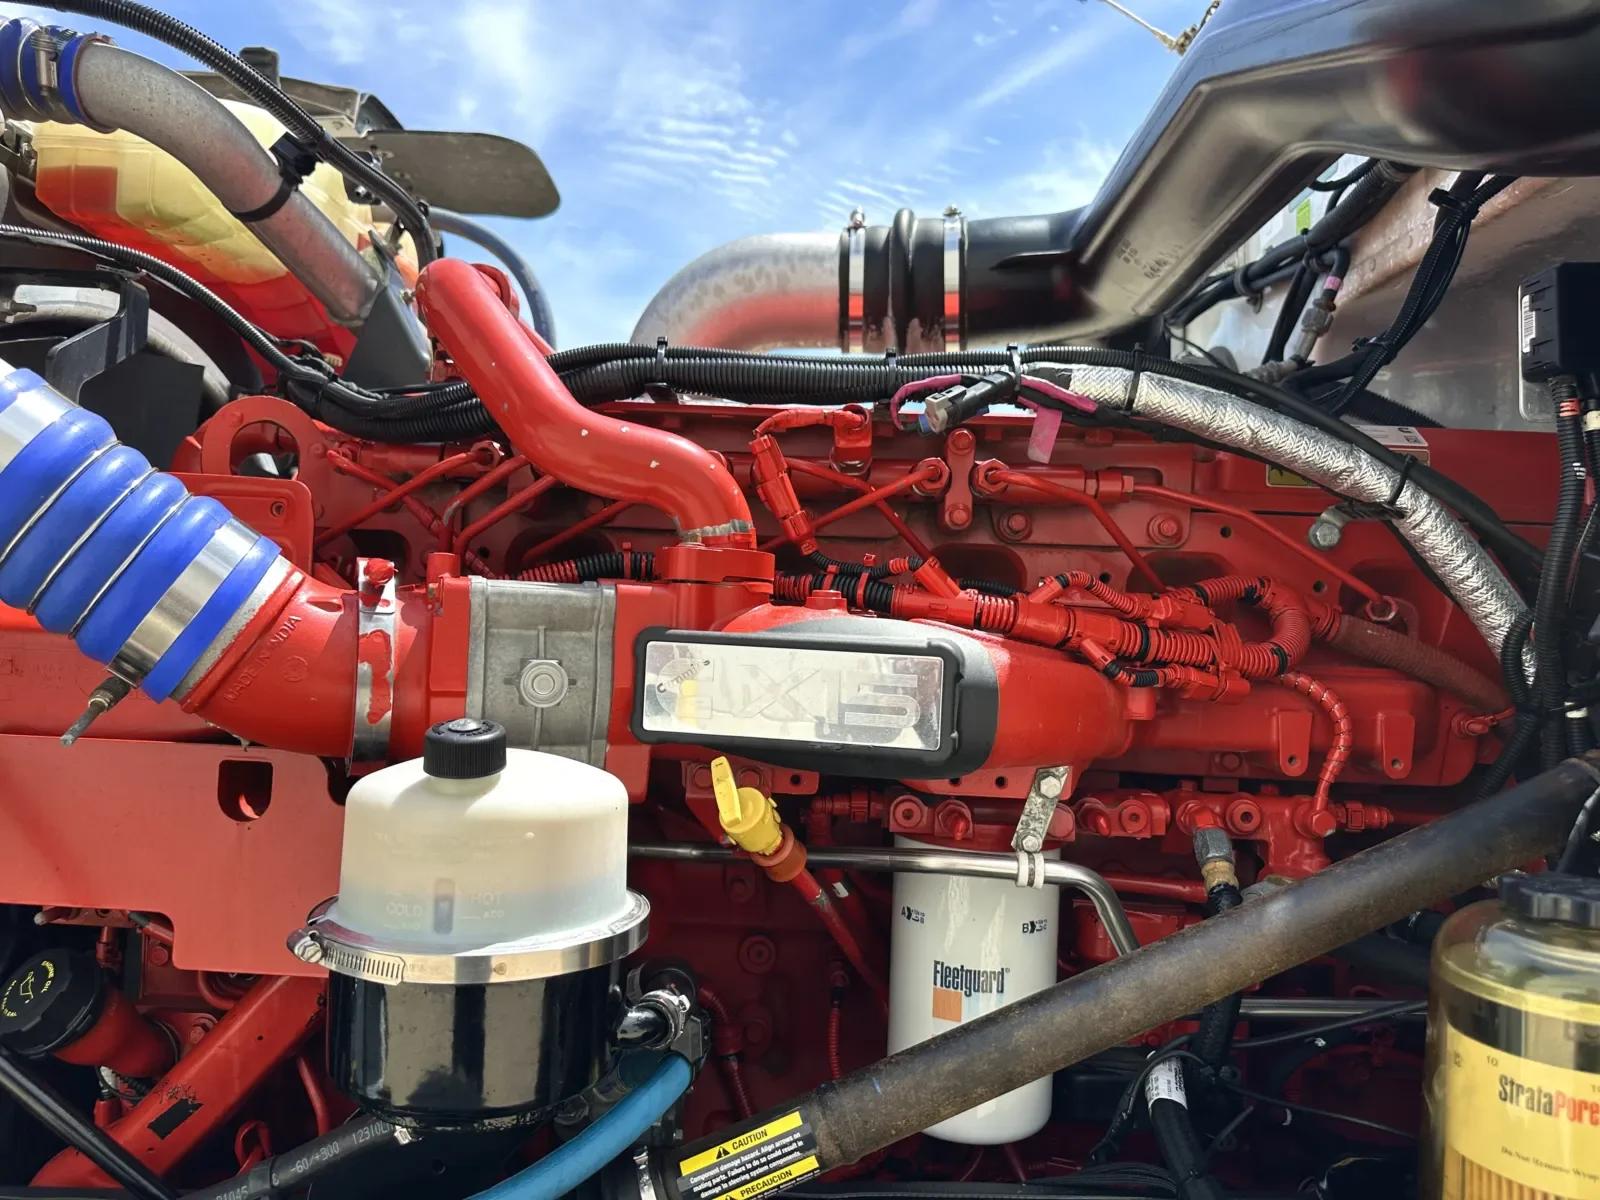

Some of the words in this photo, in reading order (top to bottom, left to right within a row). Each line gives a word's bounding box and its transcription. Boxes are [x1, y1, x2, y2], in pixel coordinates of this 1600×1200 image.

[1021, 922, 1029, 934] B
[933, 960, 1005, 997] Fleetguard
[731, 1128, 768, 1150] CAUTION
[290, 1141, 340, 1174] -60/+300
[689, 1167, 720, 1184] Component
[719, 1158, 741, 1174] damage
[760, 1142, 775, 1154] Align
[692, 1179, 712, 1193] mating
[727, 1165, 746, 1178] Failure
[781, 1142, 798, 1154] result
[700, 1185, 722, 1199] damage
[727, 1173, 750, 1189] steering
[749, 1165, 769, 1177] system
[740, 1169, 793, 1198] PRECAUCION
